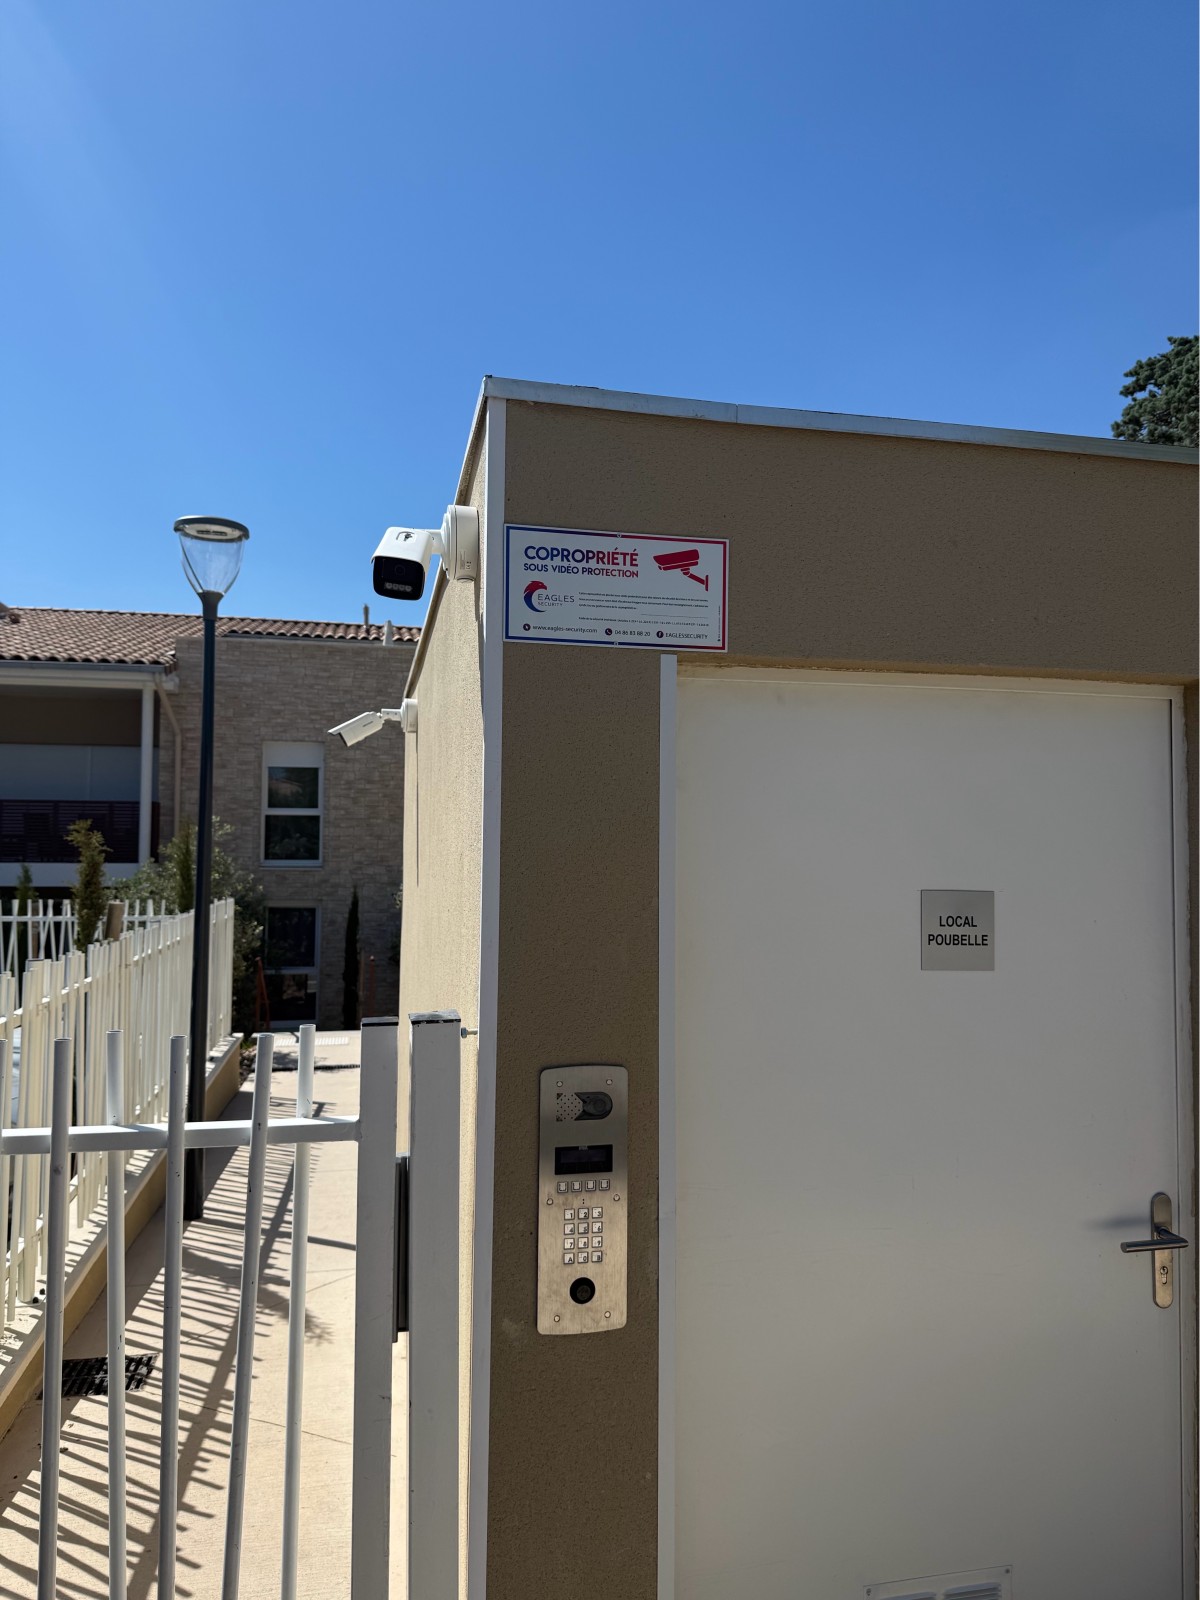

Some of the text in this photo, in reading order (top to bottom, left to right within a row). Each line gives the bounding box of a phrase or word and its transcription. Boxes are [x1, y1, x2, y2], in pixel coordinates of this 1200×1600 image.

[524, 545, 639, 567] COPROPRIÉTÉ
[523, 562, 639, 578] SOUS VIDÉO PROTECTION
[537, 593, 575, 603] EAGLES
[939, 915, 978, 928] LOCAL
[927, 933, 989, 946] POUBELLE
